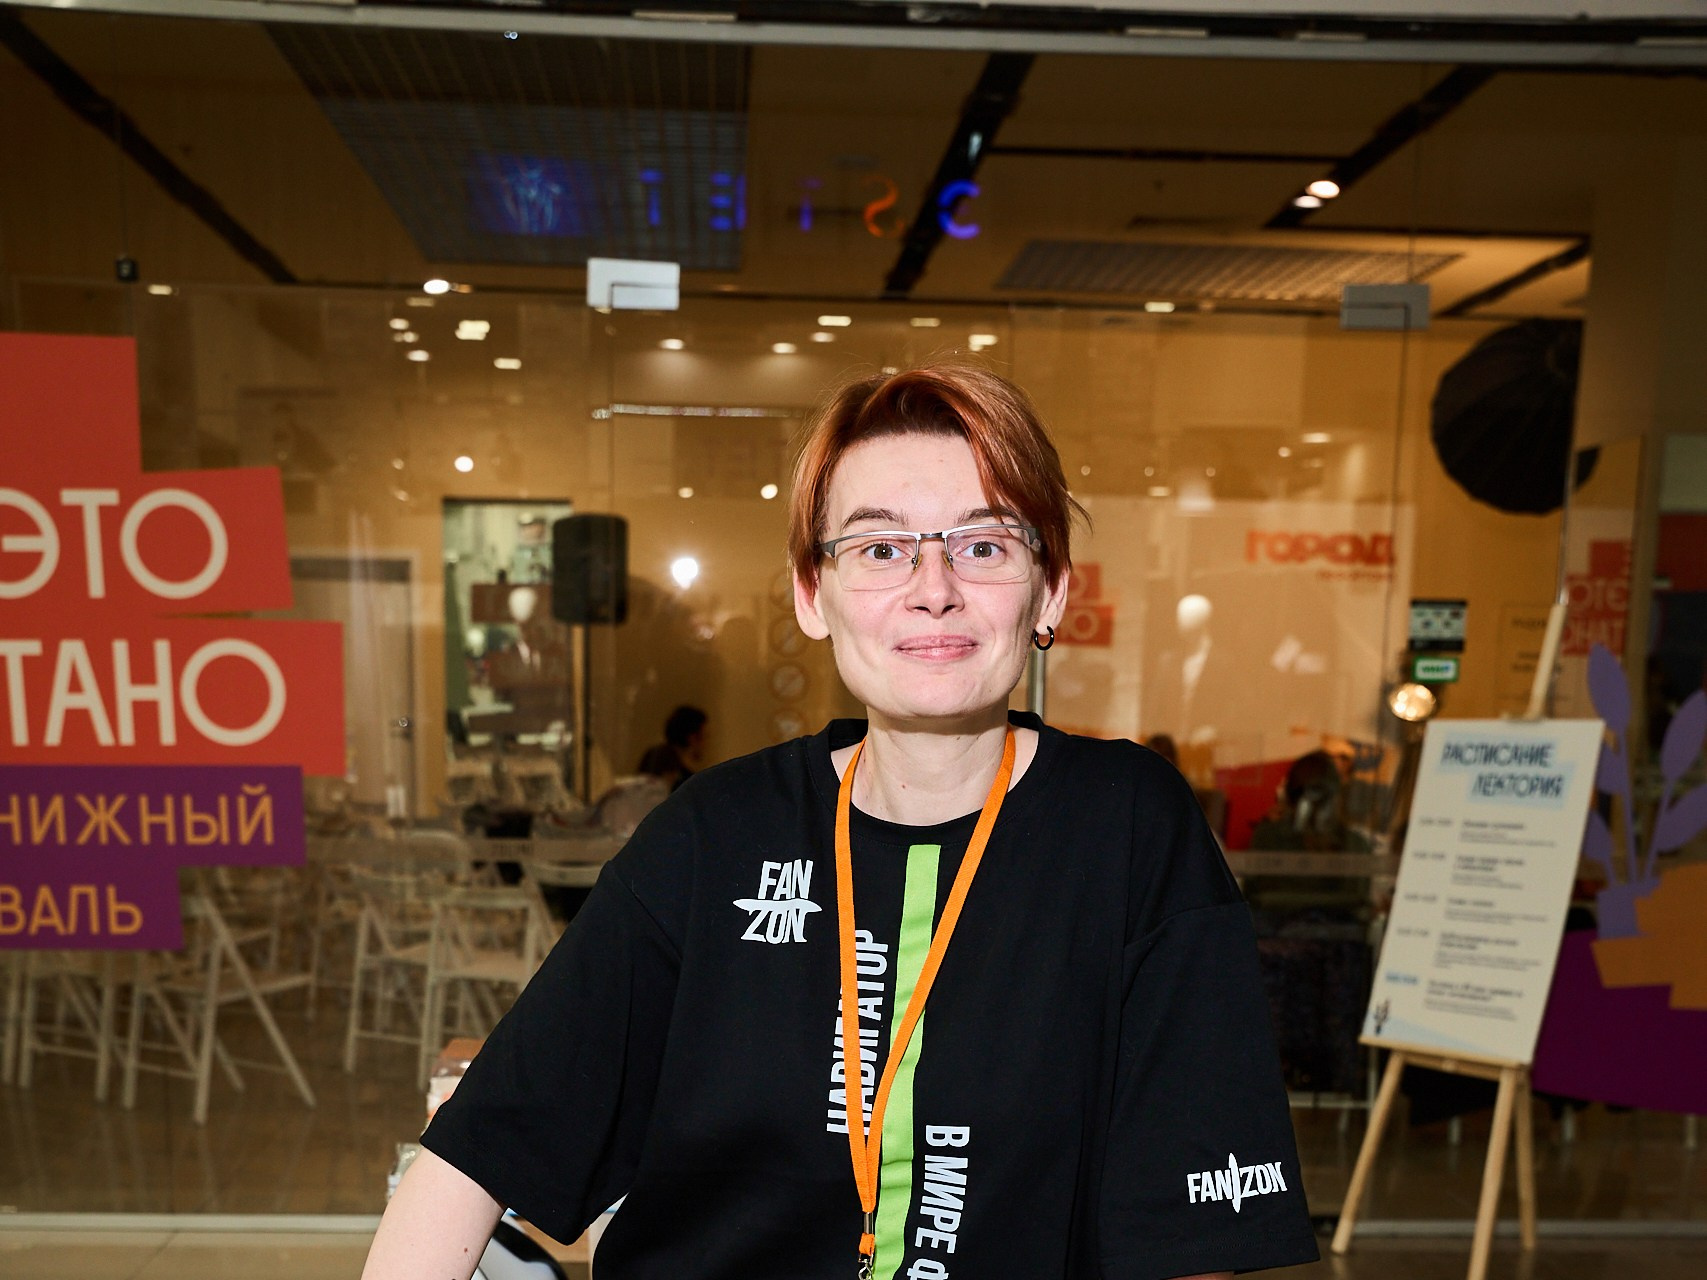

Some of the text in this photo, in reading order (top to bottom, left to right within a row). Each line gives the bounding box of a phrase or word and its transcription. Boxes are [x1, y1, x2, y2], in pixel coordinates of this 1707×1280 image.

[0, 487, 228, 600] ЭТО
[1441, 741, 1552, 768] РАСПИСАНИЕ
[1472, 773, 1564, 799] ЛЕКТОРИЯ
[758, 859, 813, 900] FAN
[926, 1125, 970, 1147] В
[915, 1154, 968, 1253] МИРЕ
